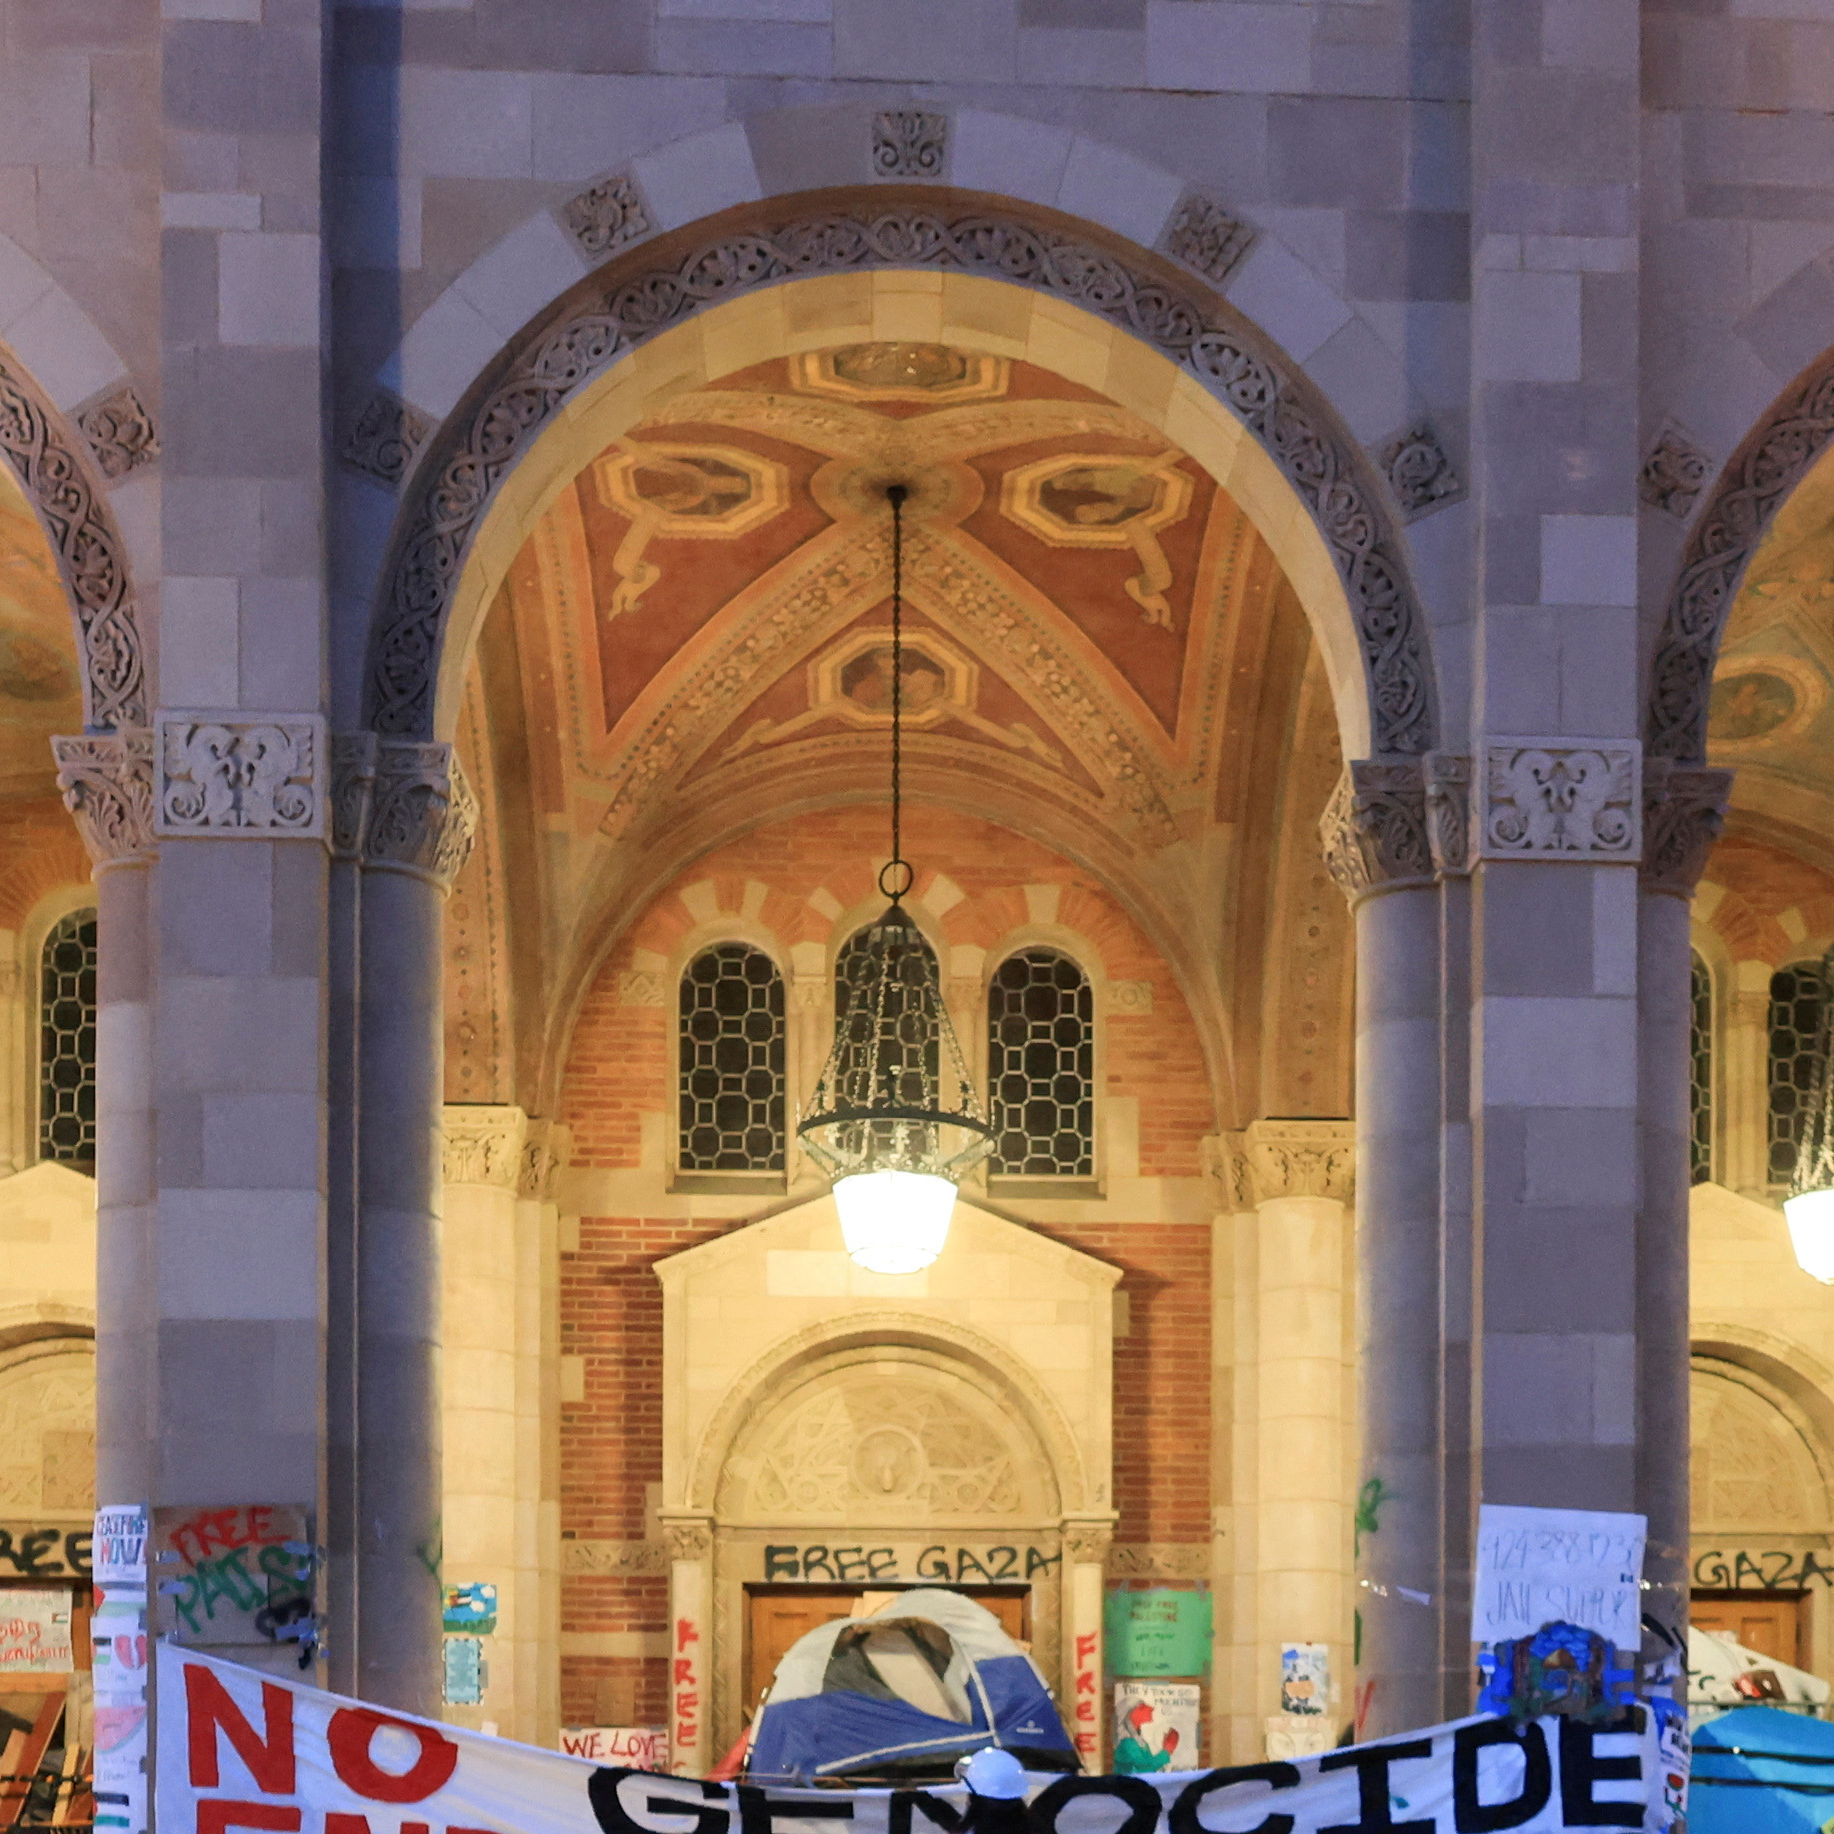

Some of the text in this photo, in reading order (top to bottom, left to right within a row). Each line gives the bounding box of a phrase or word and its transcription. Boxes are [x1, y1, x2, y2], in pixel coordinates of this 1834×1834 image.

[170, 1507, 292, 1568] FREE
[764, 1544, 1063, 1583] FREE GAZA
[673, 1617, 700, 1748] FREE
[1075, 1630, 1098, 1754] FREE
[182, 1662, 459, 1804] NO
[562, 1732, 668, 1759] WE LOVE
